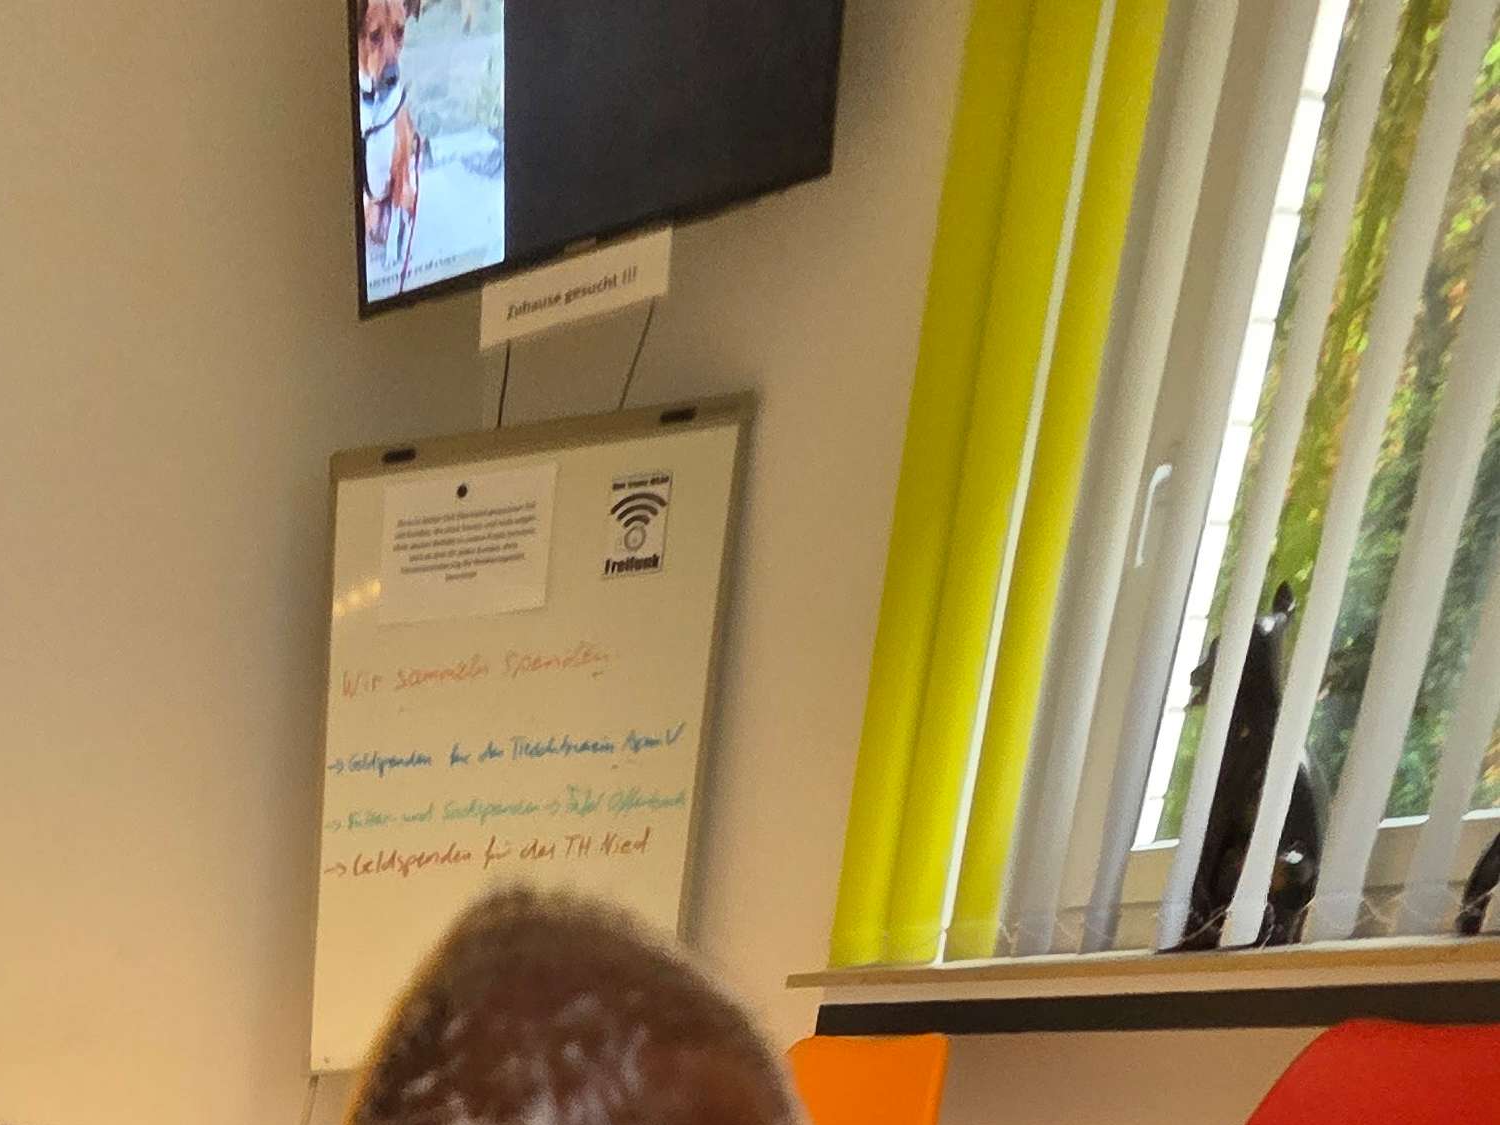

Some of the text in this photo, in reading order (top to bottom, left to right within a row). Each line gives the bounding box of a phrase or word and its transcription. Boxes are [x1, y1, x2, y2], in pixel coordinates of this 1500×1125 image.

[507, 293, 562, 321] Zuhause
[564, 274, 617, 305] gesucht
[342, 669, 382, 698] Wir
[352, 841, 473, 878] Geldspenden
[564, 833, 593, 860] TH
